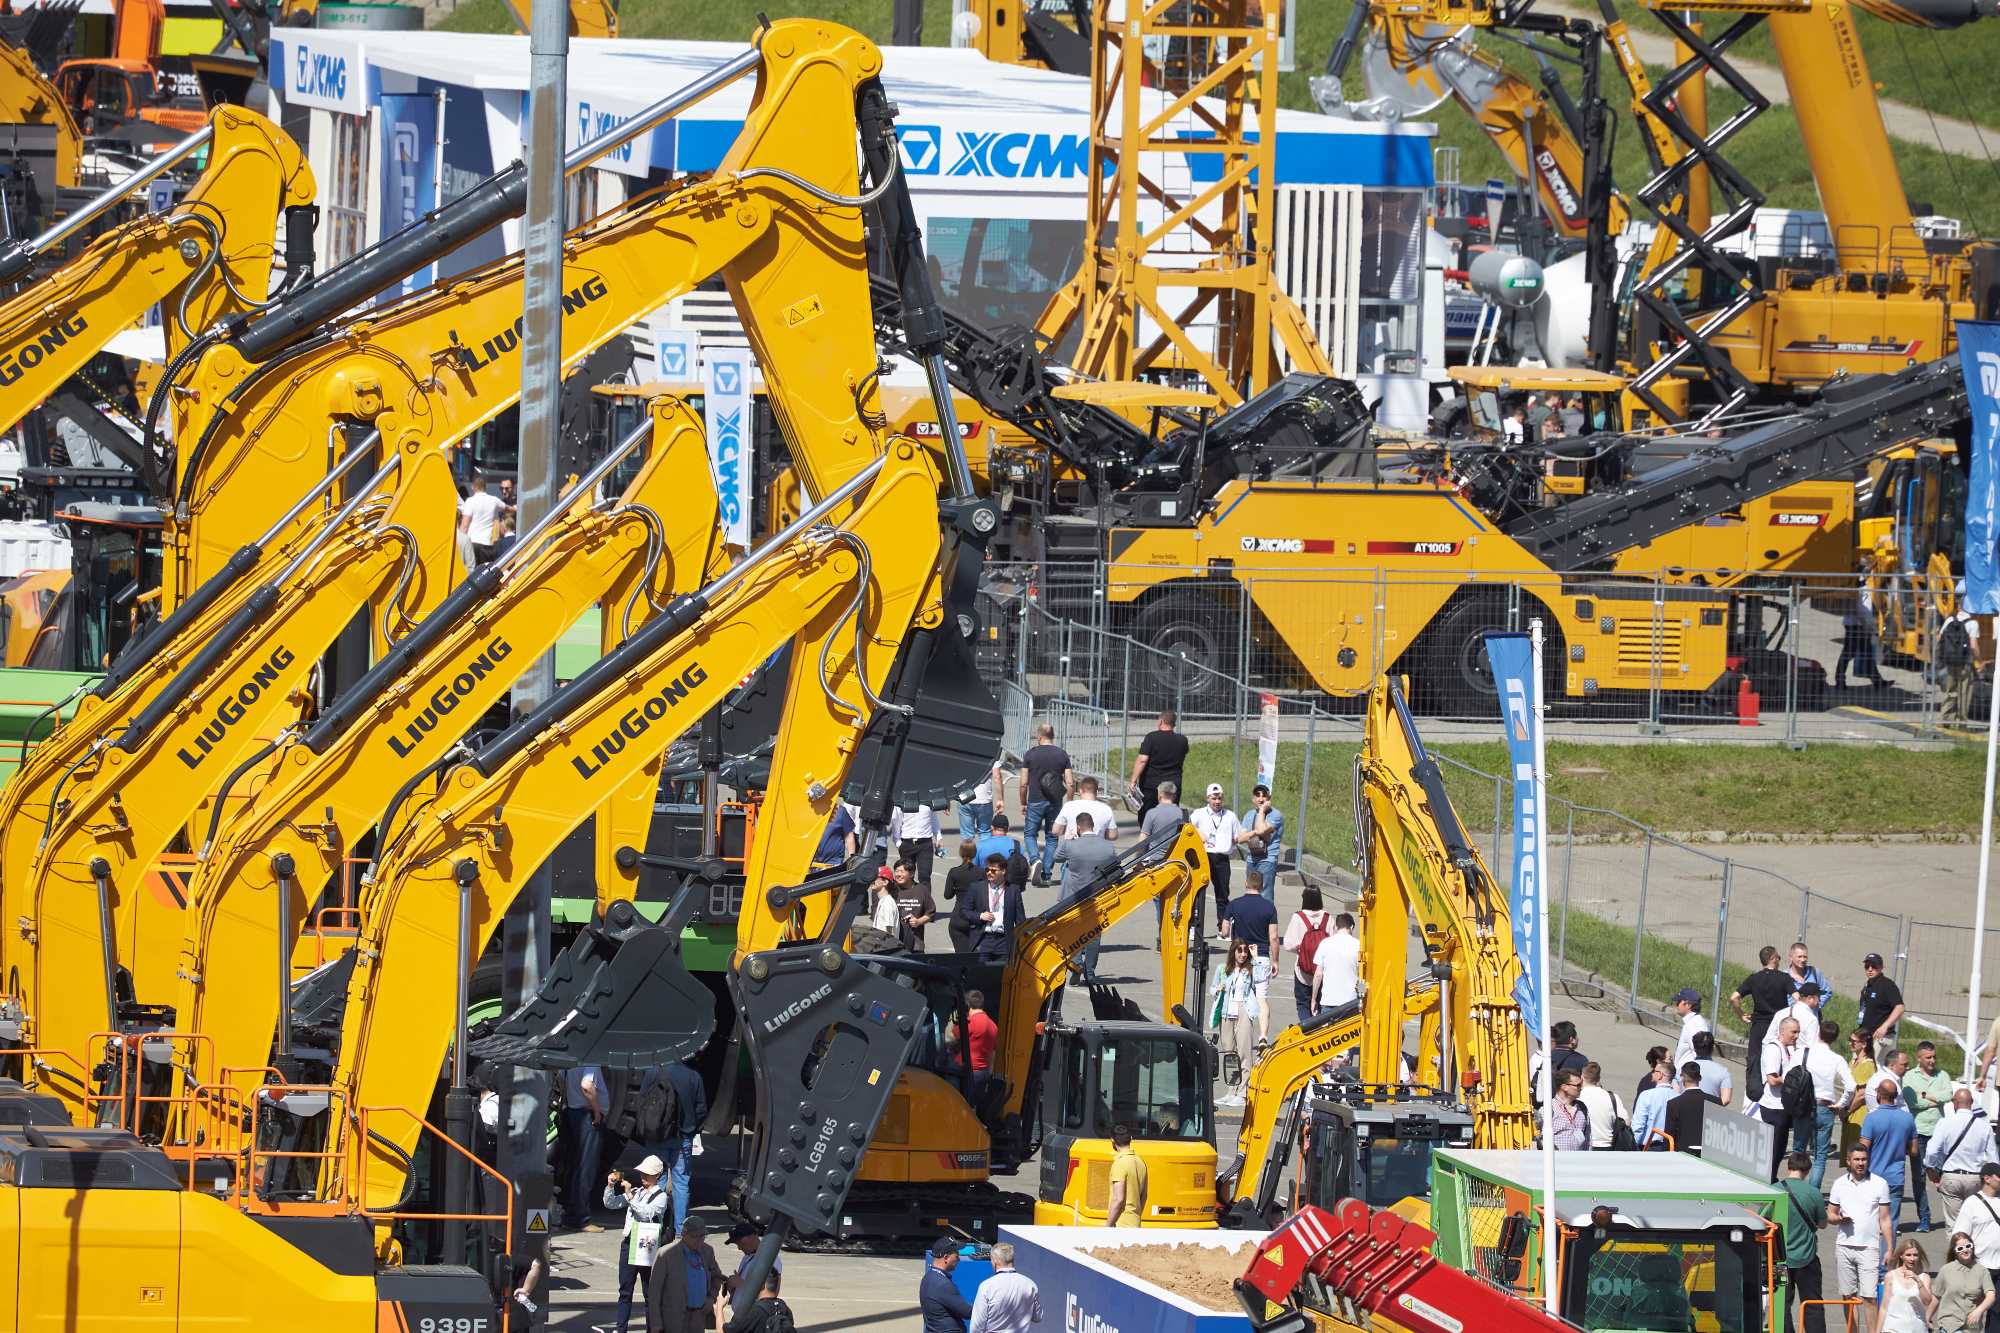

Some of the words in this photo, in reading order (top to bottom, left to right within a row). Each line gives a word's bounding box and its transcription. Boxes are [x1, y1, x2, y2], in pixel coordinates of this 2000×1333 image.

[311, 53, 347, 100] XCMG
[1544, 168, 1577, 216] XCMG
[1256, 538, 1306, 552] XCMG
[1308, 1027, 1361, 1057] LIUGON
[805, 1117, 837, 1173] LGB165
[420, 1318, 488, 1333] 939F
